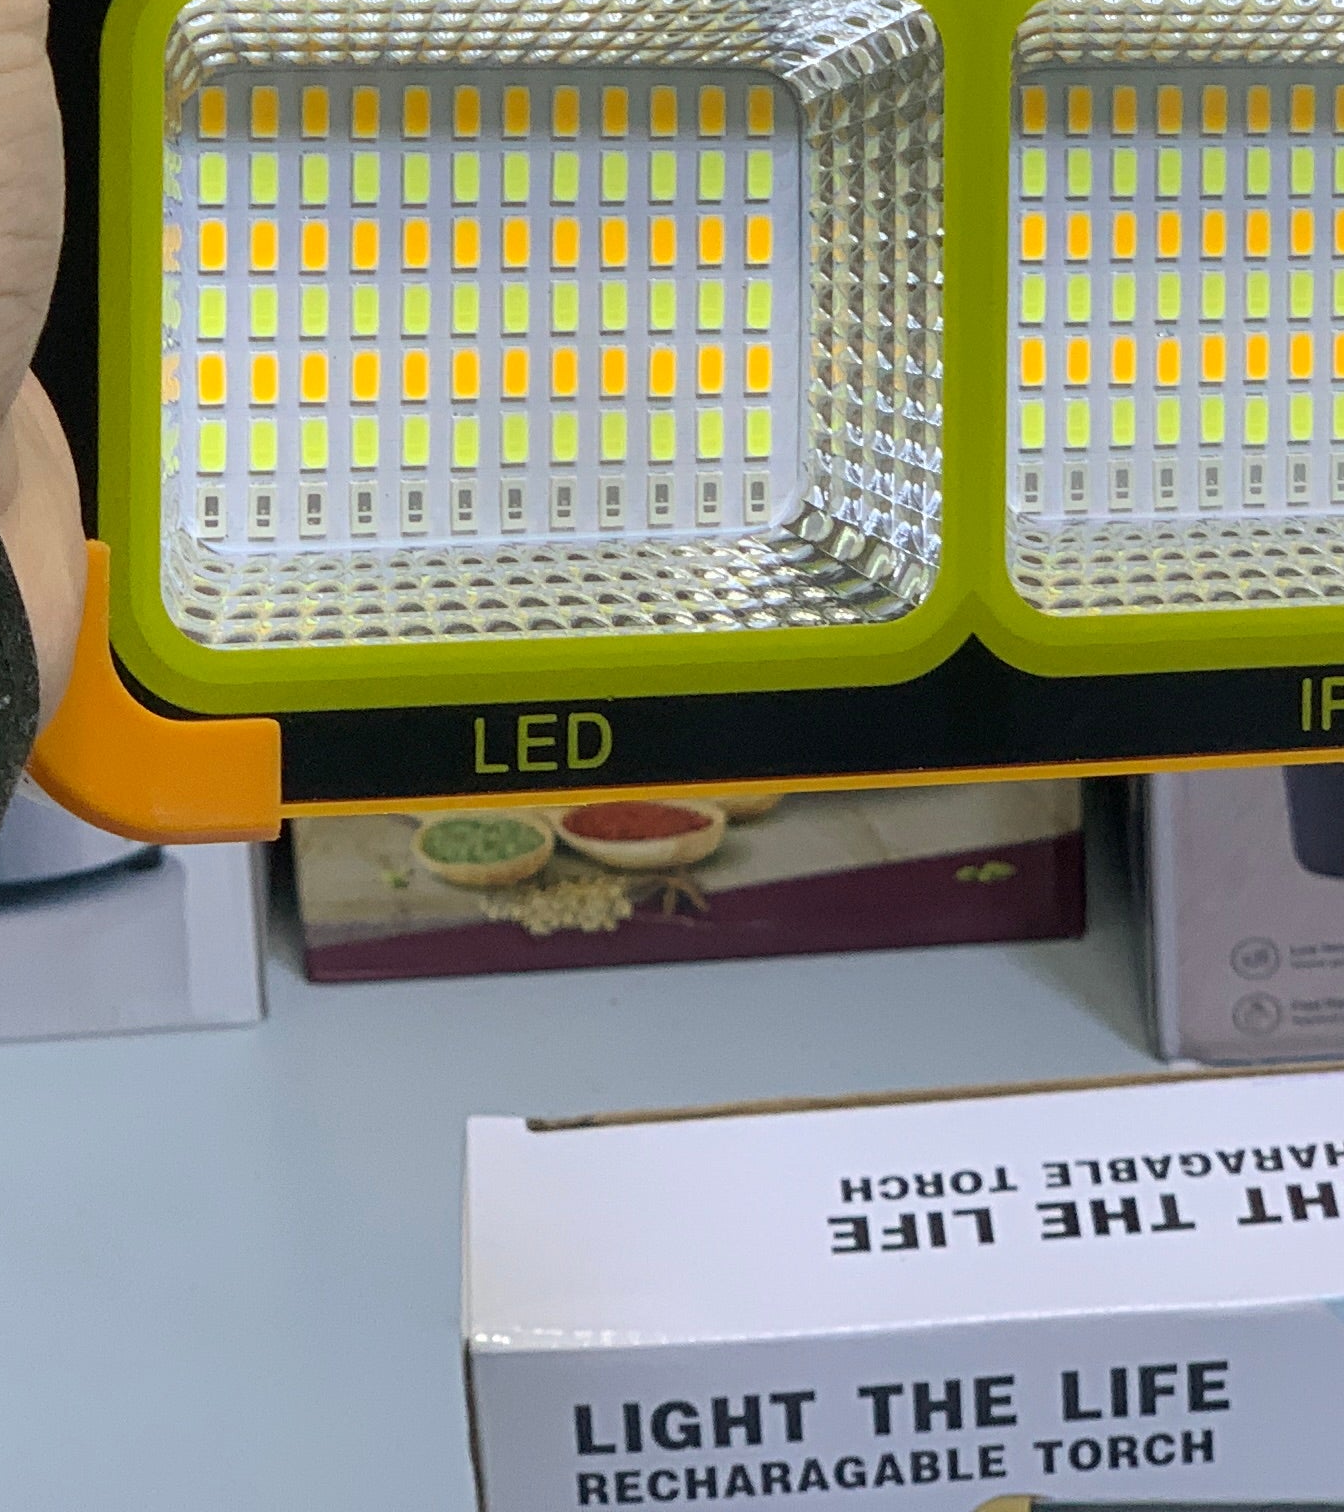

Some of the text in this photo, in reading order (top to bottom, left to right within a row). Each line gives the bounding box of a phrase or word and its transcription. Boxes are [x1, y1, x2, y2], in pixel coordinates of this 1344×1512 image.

[471, 713, 614, 774] LED
[840, 1164, 1019, 1205] TORCH
[826, 1207, 996, 1255] LIFE
[1040, 1192, 1196, 1241] THE
[572, 1360, 1232, 1458] LIGHT THE LIFE
[576, 1428, 1217, 1508] RECHARAGABLE TORCH
